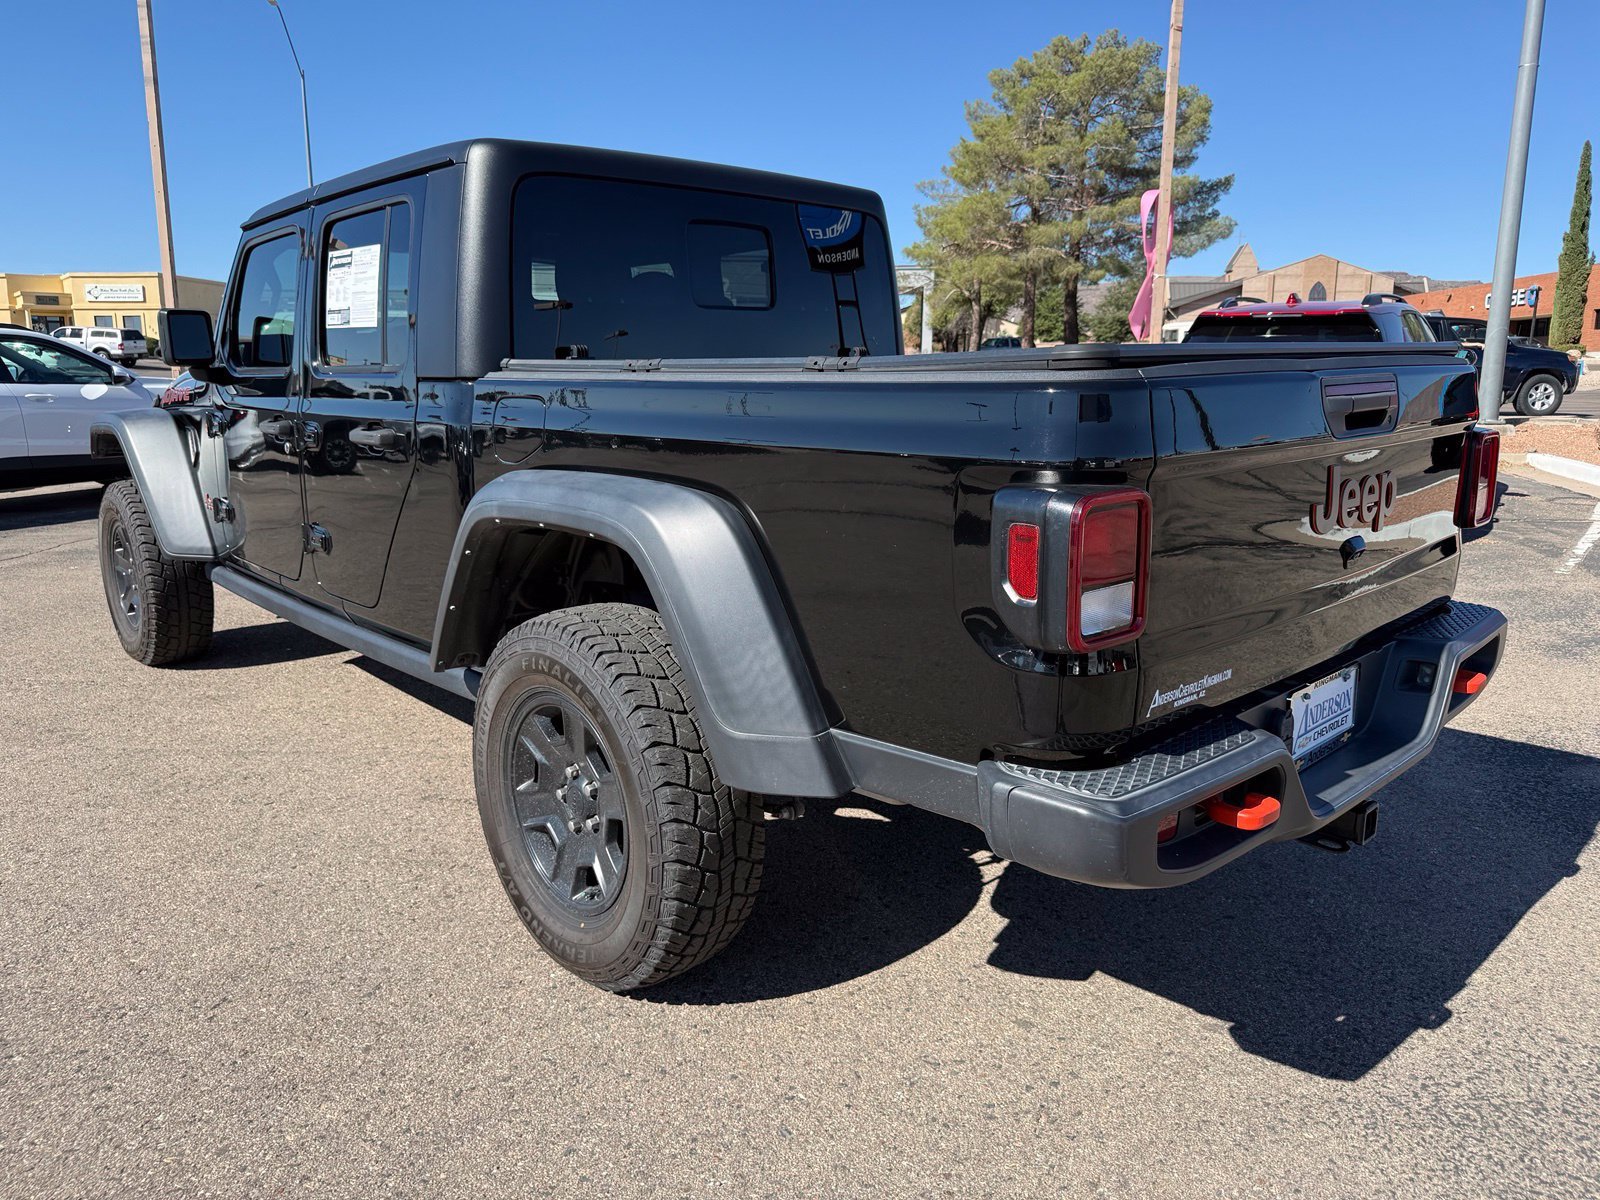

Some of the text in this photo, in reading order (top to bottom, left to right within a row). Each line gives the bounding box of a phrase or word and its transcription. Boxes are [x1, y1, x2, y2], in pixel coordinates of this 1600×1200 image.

[1485, 289, 1526, 309] CSE
[1309, 464, 1398, 535] Jeep
[1292, 687, 1352, 756] ANDERSON
[1312, 714, 1349, 741] CHEVROLET
